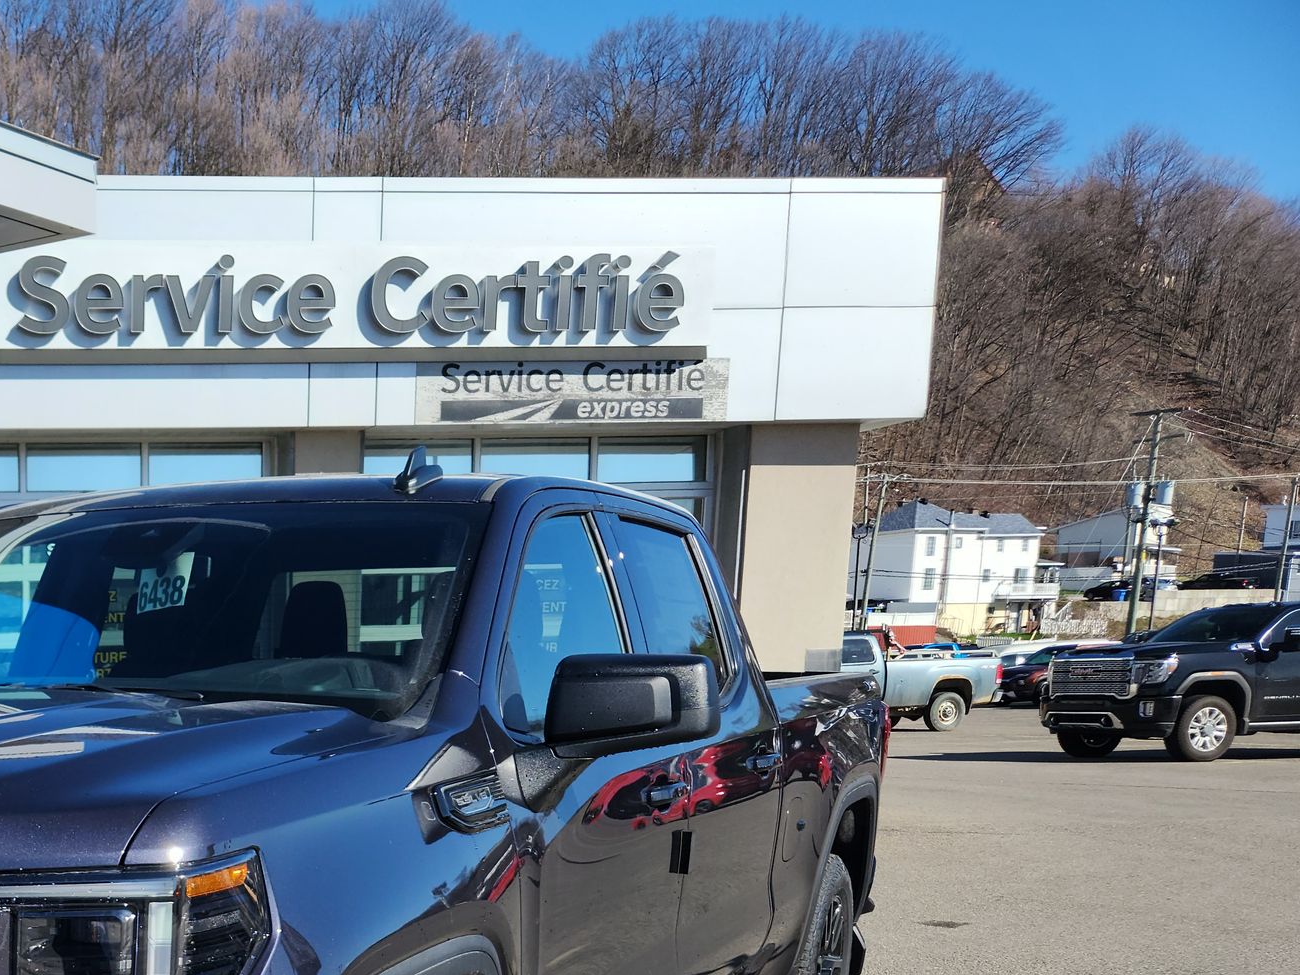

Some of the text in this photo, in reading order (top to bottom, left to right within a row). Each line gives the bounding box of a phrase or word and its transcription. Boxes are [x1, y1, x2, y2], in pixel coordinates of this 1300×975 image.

[16, 250, 685, 337] Service Certifié
[440, 360, 706, 395] Service Certifié
[576, 400, 670, 422] express
[138, 575, 186, 612] 6438
